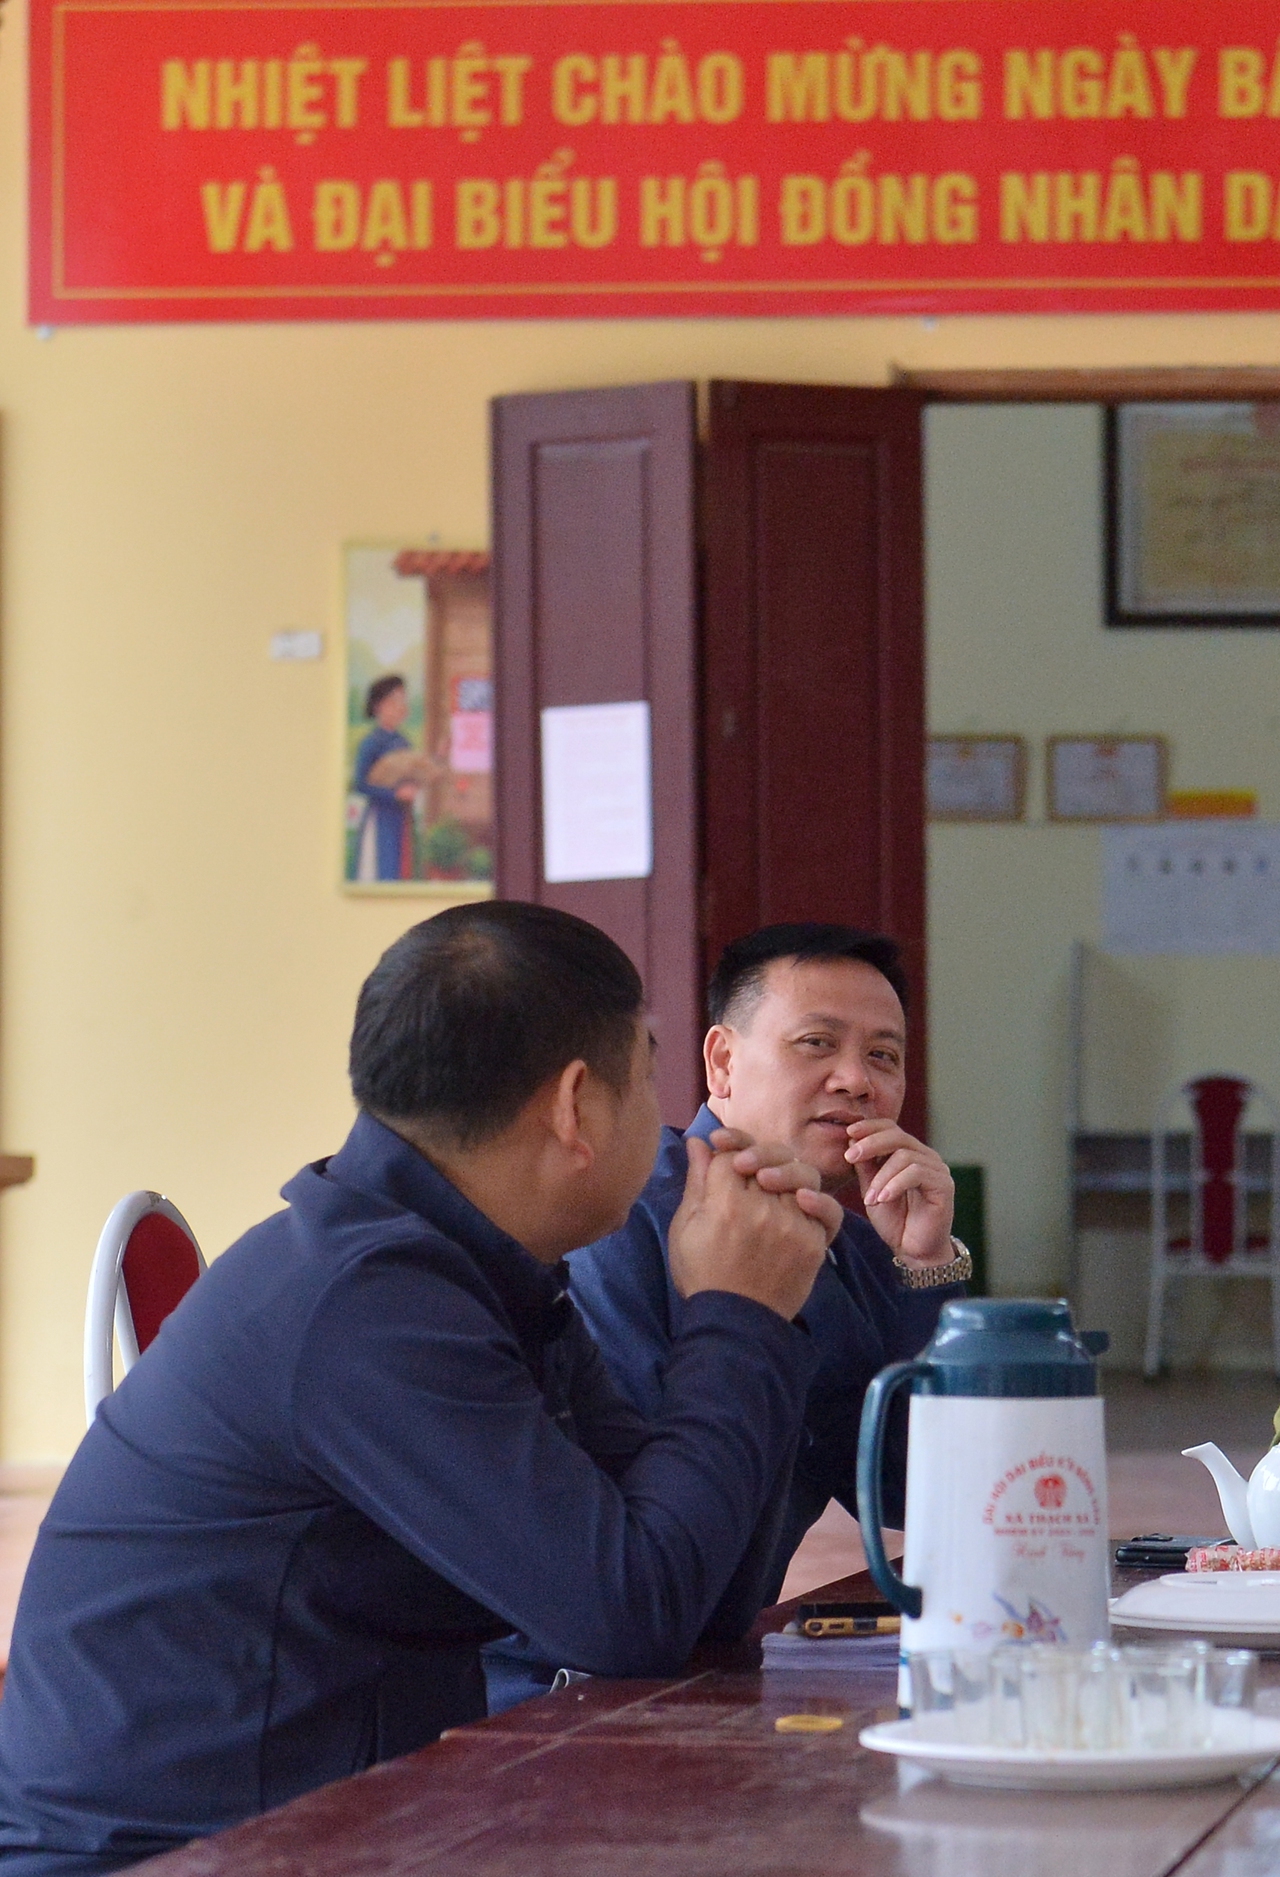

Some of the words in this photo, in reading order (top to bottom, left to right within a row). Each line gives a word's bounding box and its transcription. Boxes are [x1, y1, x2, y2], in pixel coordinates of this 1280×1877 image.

[160, 43, 368, 145] NHIỆT
[387, 42, 532, 143] LIỆT
[552, 40, 744, 127] CHÀO
[766, 35, 981, 122] MỪNG
[1003, 33, 1197, 120] NGÀY
[200, 166, 295, 253] VÀ
[311, 180, 433, 267] ĐẠI
[456, 148, 618, 250] BIỂU
[640, 160, 759, 262] HỘI
[1000, 156, 1203, 243] NHÂN
